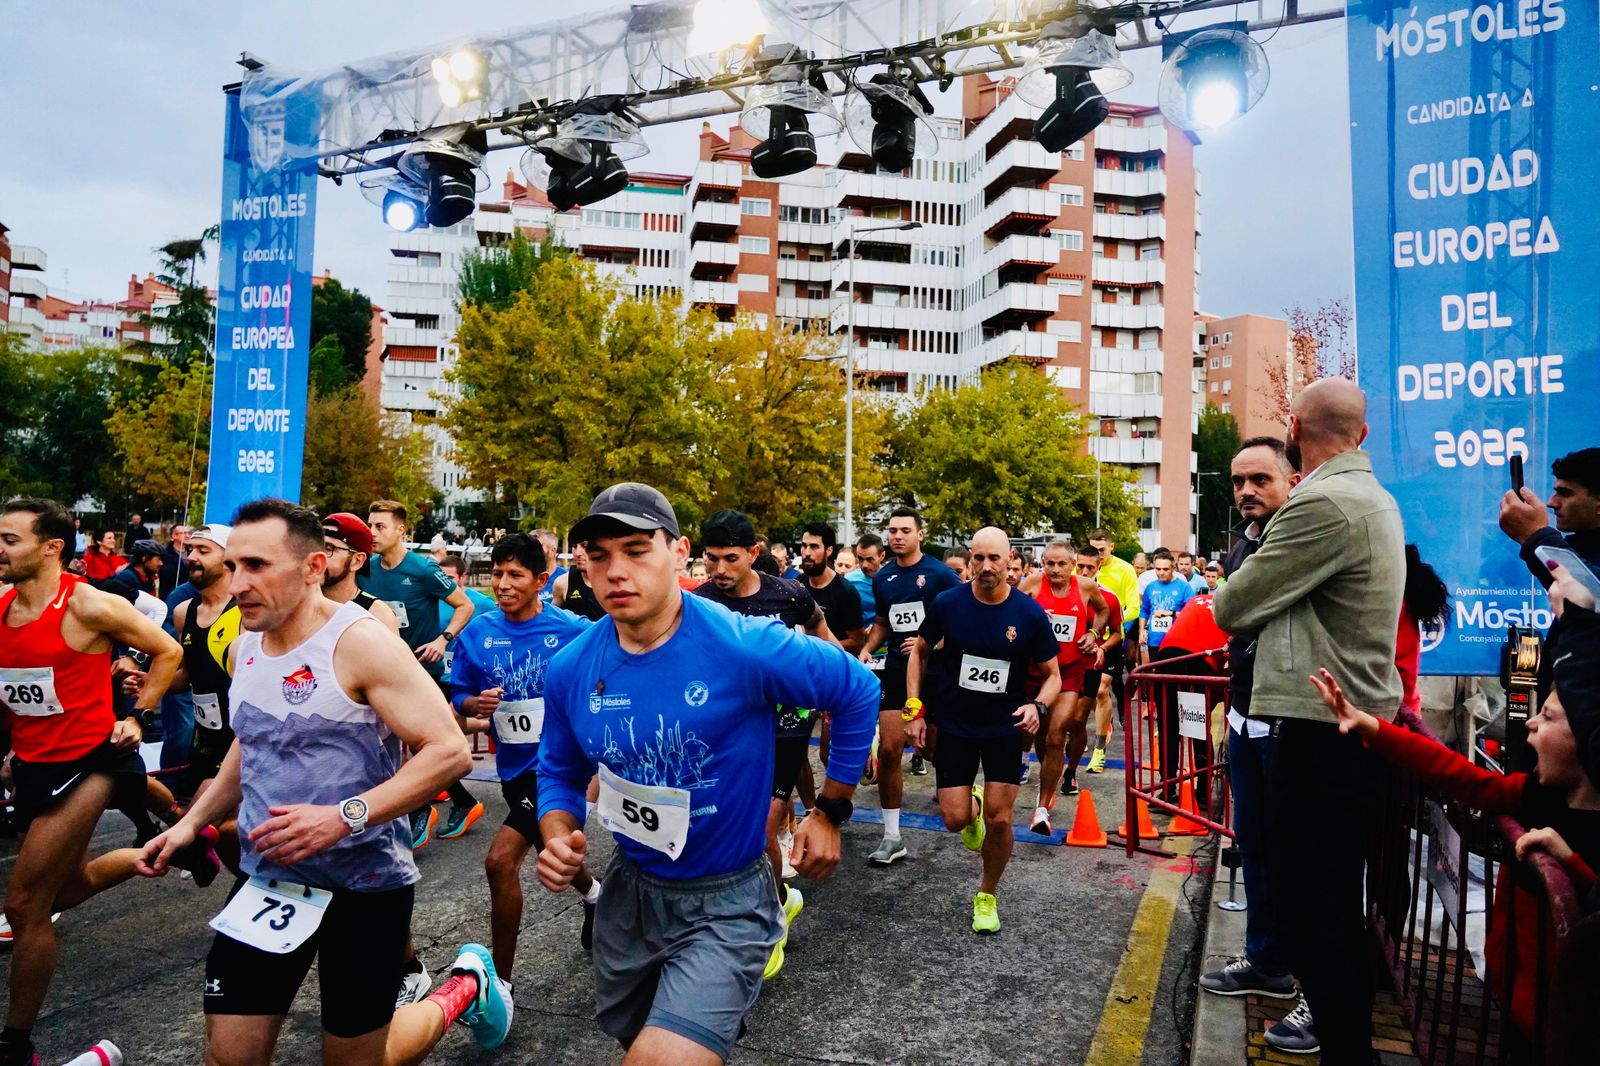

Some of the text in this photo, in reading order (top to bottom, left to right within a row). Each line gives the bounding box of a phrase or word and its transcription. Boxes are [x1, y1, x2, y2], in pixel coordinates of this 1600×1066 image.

[1376, 0, 1566, 61] MÓSTOLES
[1407, 87, 1535, 125] CANDIDATA A
[1408, 149, 1538, 199] CIUDAD
[232, 192, 307, 221] MÓSTOLES
[1393, 215, 1560, 268] EUROPEA
[243, 247, 293, 262] CANDIDATA A
[241, 285, 292, 309] CIUDAD
[1441, 291, 1512, 331] DEL
[232, 327, 295, 350] EUROPEA
[248, 368, 275, 391] DEL
[1398, 355, 1564, 401] DEPORTE
[228, 409, 290, 432] DEPORTE
[1435, 427, 1528, 467] 2026
[238, 449, 274, 473] 2026
[1456, 587, 1518, 597] Ayuntamiento
[1519, 588, 1532, 596] de
[895, 611, 918, 625] 251
[1154, 620, 1168, 628] 233
[1456, 600, 1555, 629] Mósto
[1459, 634, 1502, 644] Concejalía
[968, 667, 999, 684] 246
[4, 684, 44, 704] 269
[507, 715, 531, 732] 10
[622, 798, 659, 832] 59
[252, 896, 296, 931] 73
